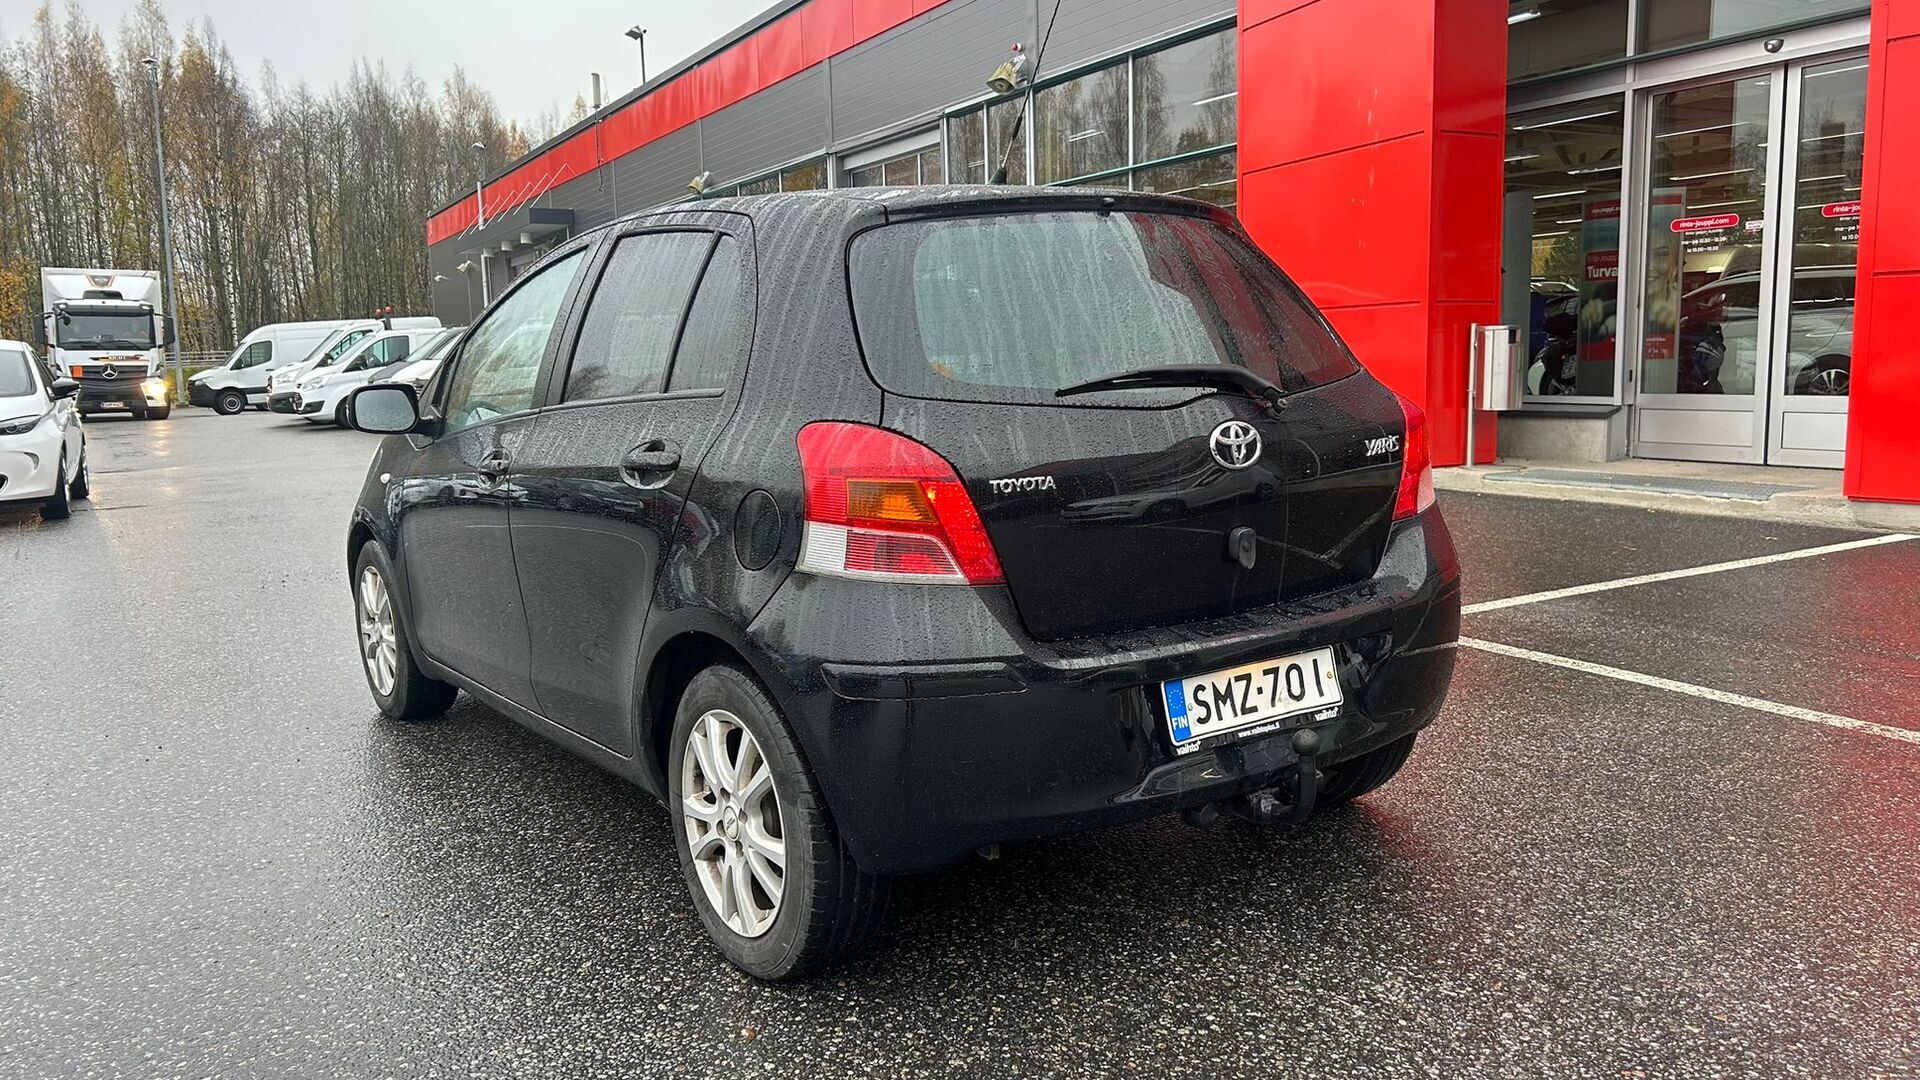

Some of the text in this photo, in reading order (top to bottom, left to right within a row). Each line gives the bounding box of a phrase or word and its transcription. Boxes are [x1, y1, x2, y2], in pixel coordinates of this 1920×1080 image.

[1679, 217, 1729, 229] rinta-jouppi.com
[1587, 265, 1618, 279] Turva
[988, 475, 1057, 494] TOYOTA
[1192, 658, 1325, 725] SMZ-701
[1171, 715, 1189, 731] FIN
